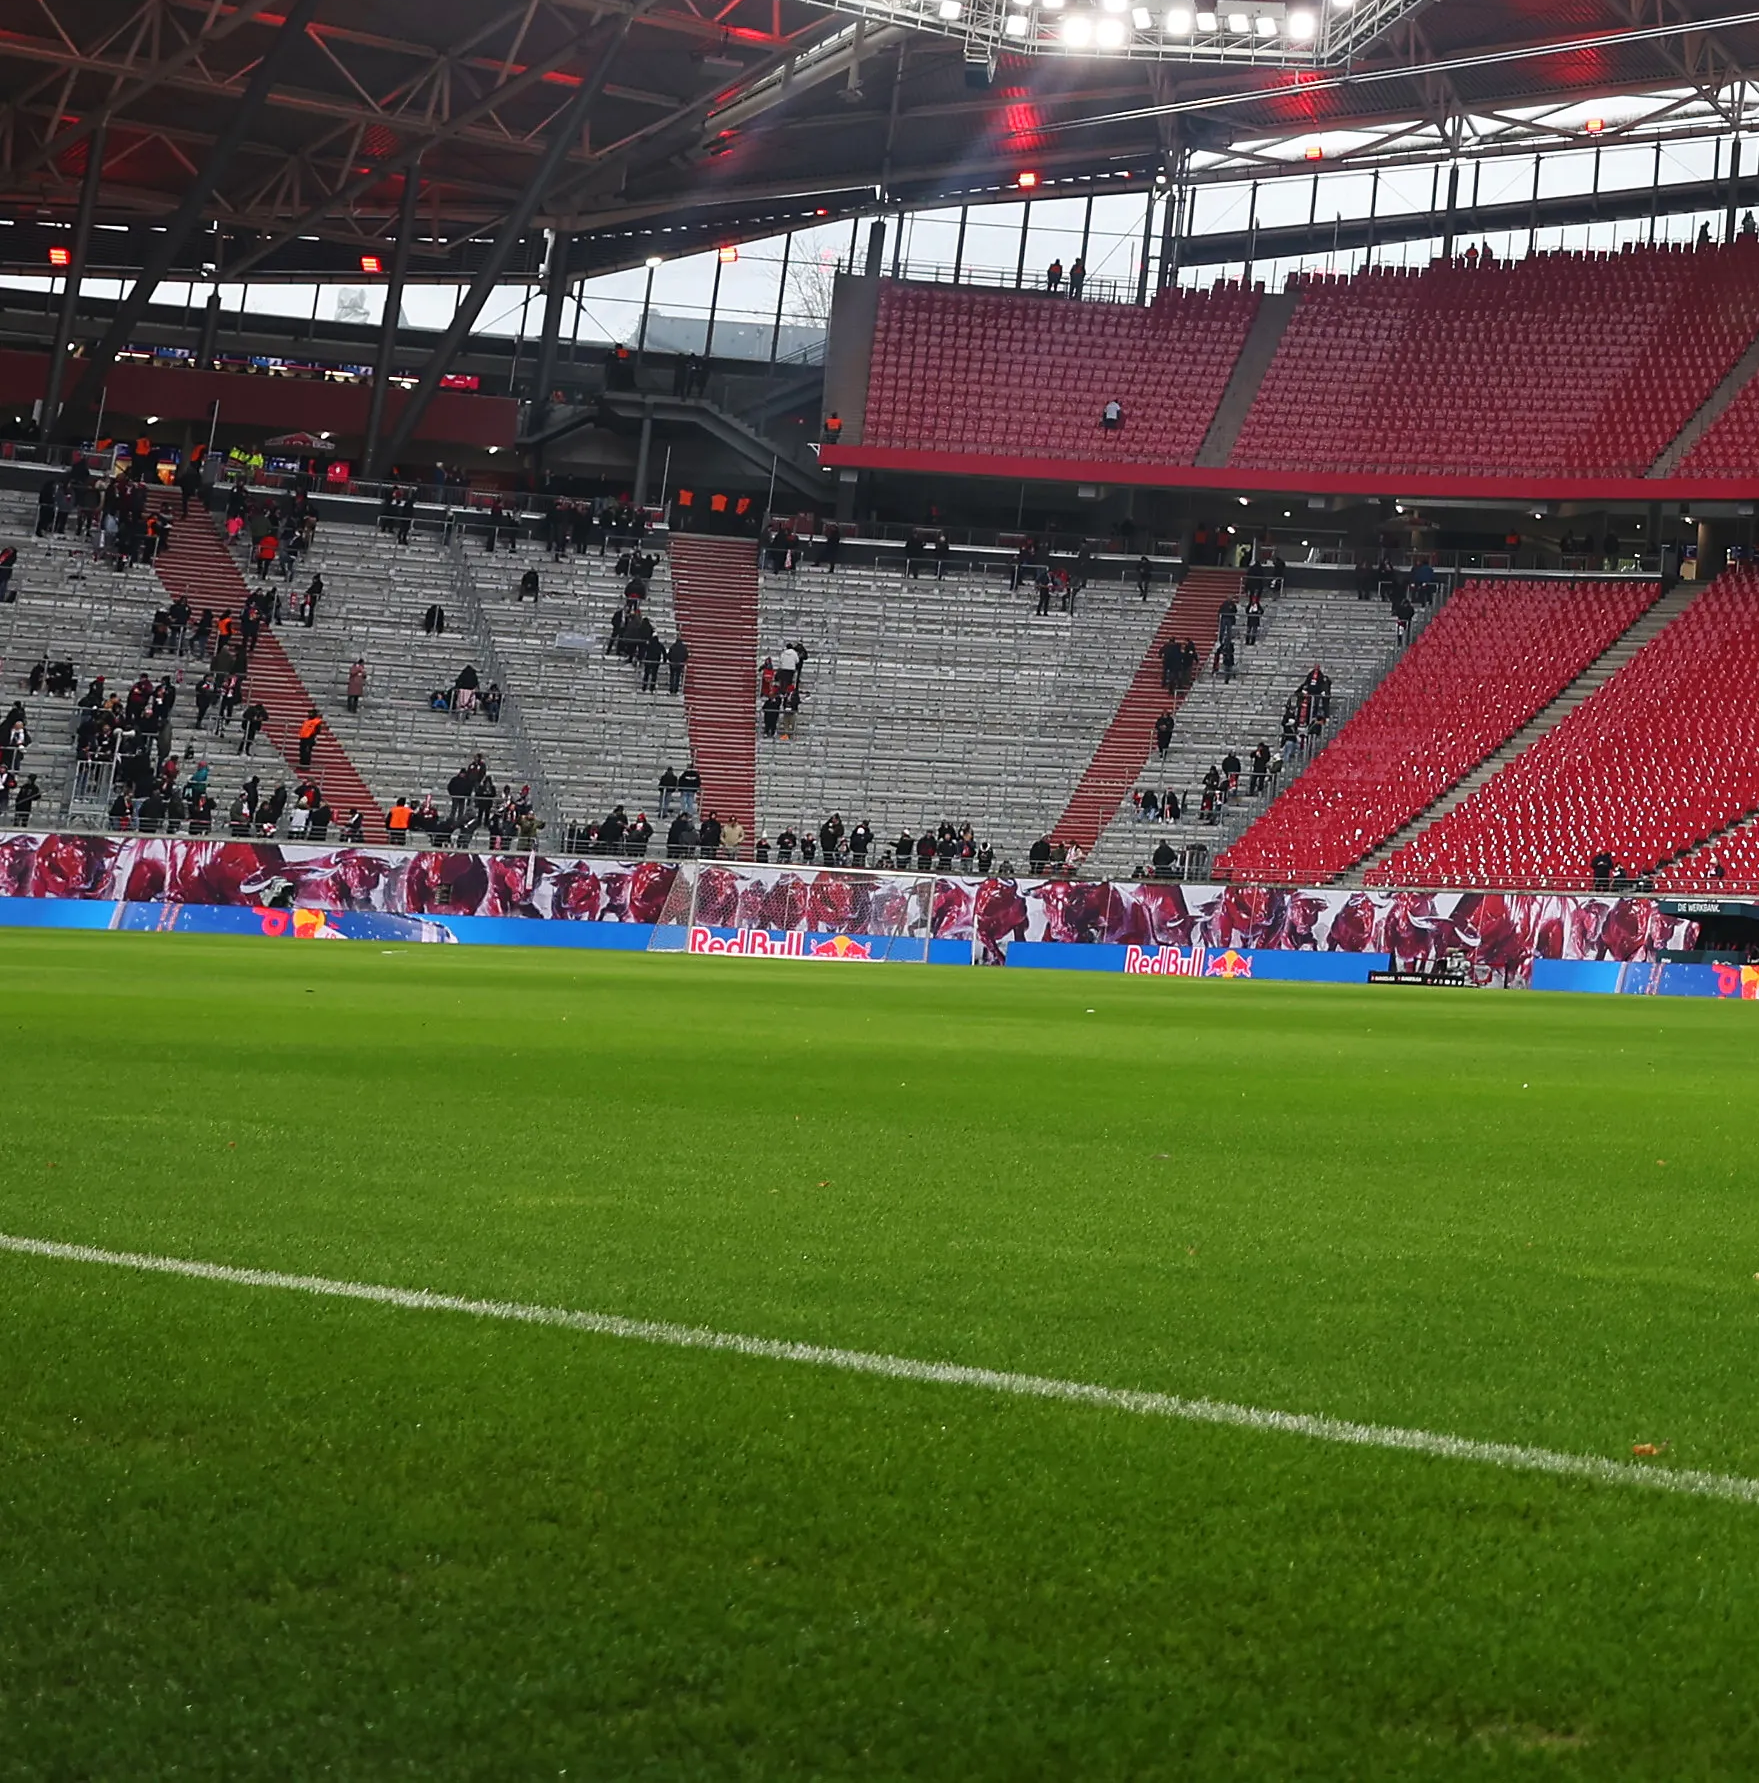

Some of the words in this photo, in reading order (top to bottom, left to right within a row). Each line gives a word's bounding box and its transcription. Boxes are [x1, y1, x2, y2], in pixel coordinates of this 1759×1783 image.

[689, 927, 747, 954] Red
[749, 930, 804, 957] Bull
[1125, 945, 1166, 974] Red
[1164, 946, 1205, 977] Bull
